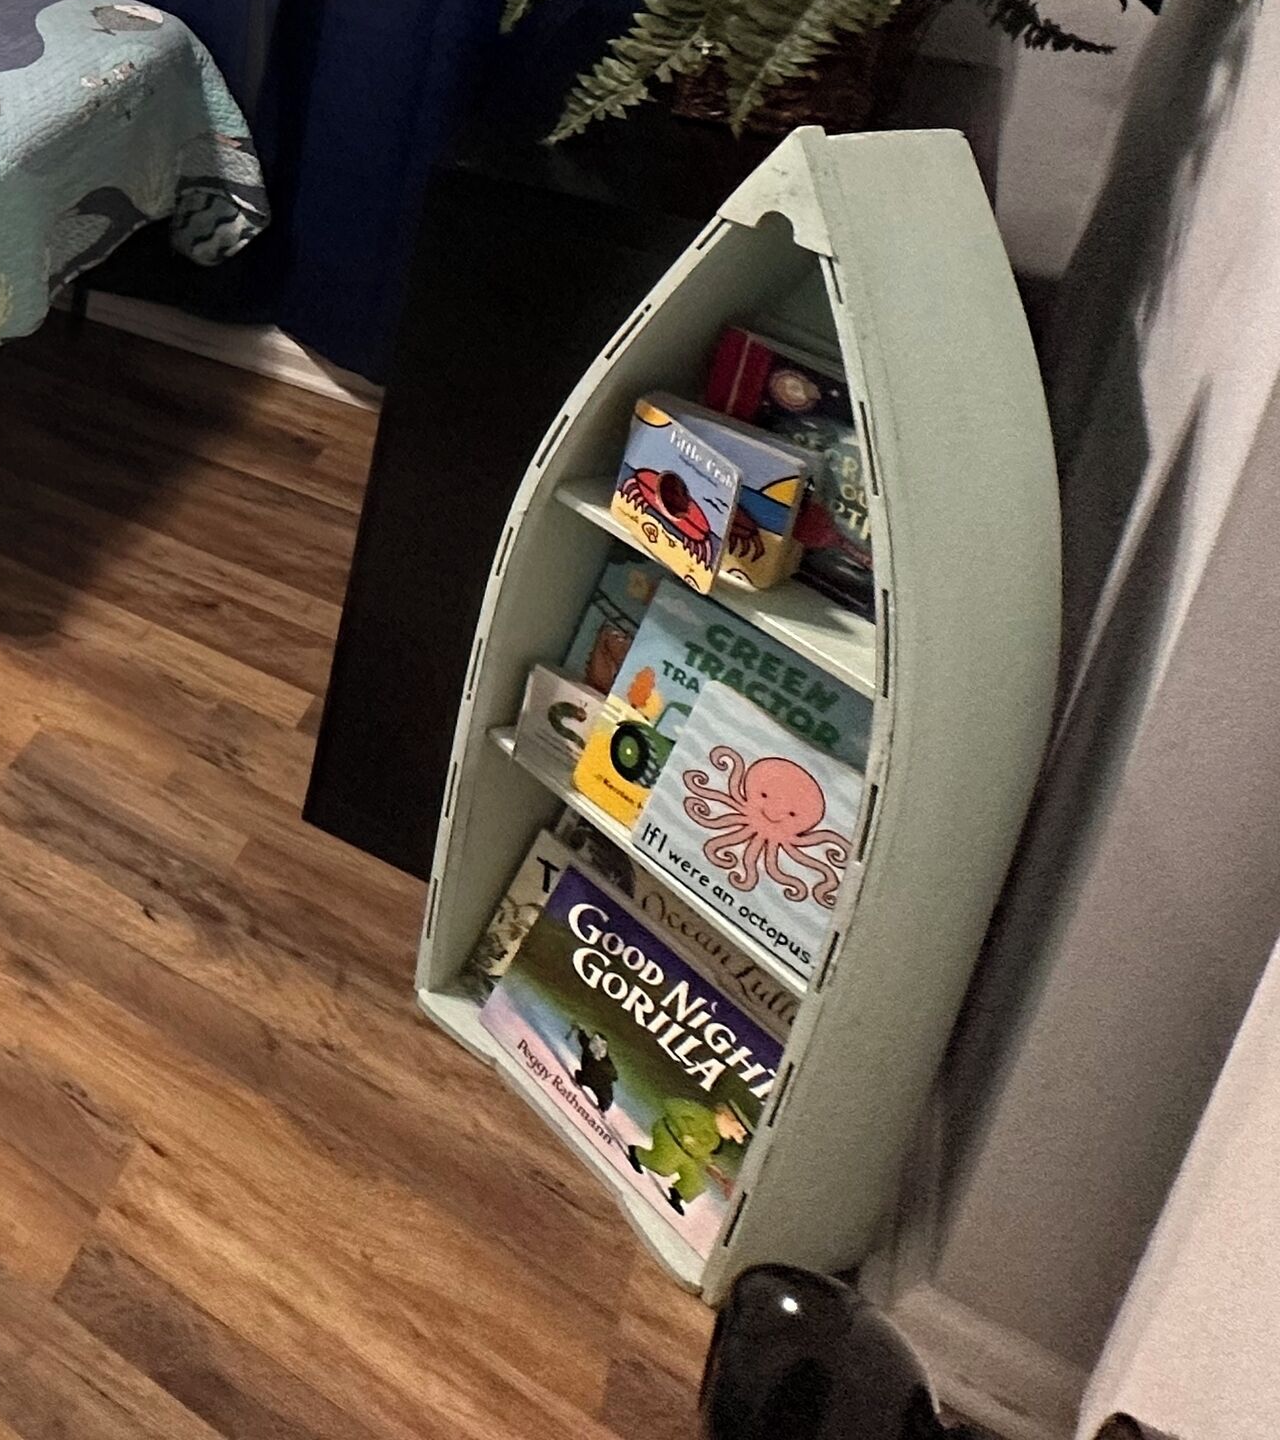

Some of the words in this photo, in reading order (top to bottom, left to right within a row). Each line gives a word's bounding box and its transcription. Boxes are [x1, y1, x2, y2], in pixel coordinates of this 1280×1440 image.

[684, 640, 840, 751] TRACTOR
[705, 623, 840, 714] GREEN
[641, 822, 661, 846] If
[657, 833, 668, 853] I
[669, 850, 710, 887] were
[712, 885, 735, 907] an
[567, 902, 665, 987] GOOD
[642, 891, 733, 967] Ocean
[572, 946, 727, 1093] GORILLA
[516, 1038, 553, 1081] Peggy
[551, 1074, 614, 1146] Rathmann
